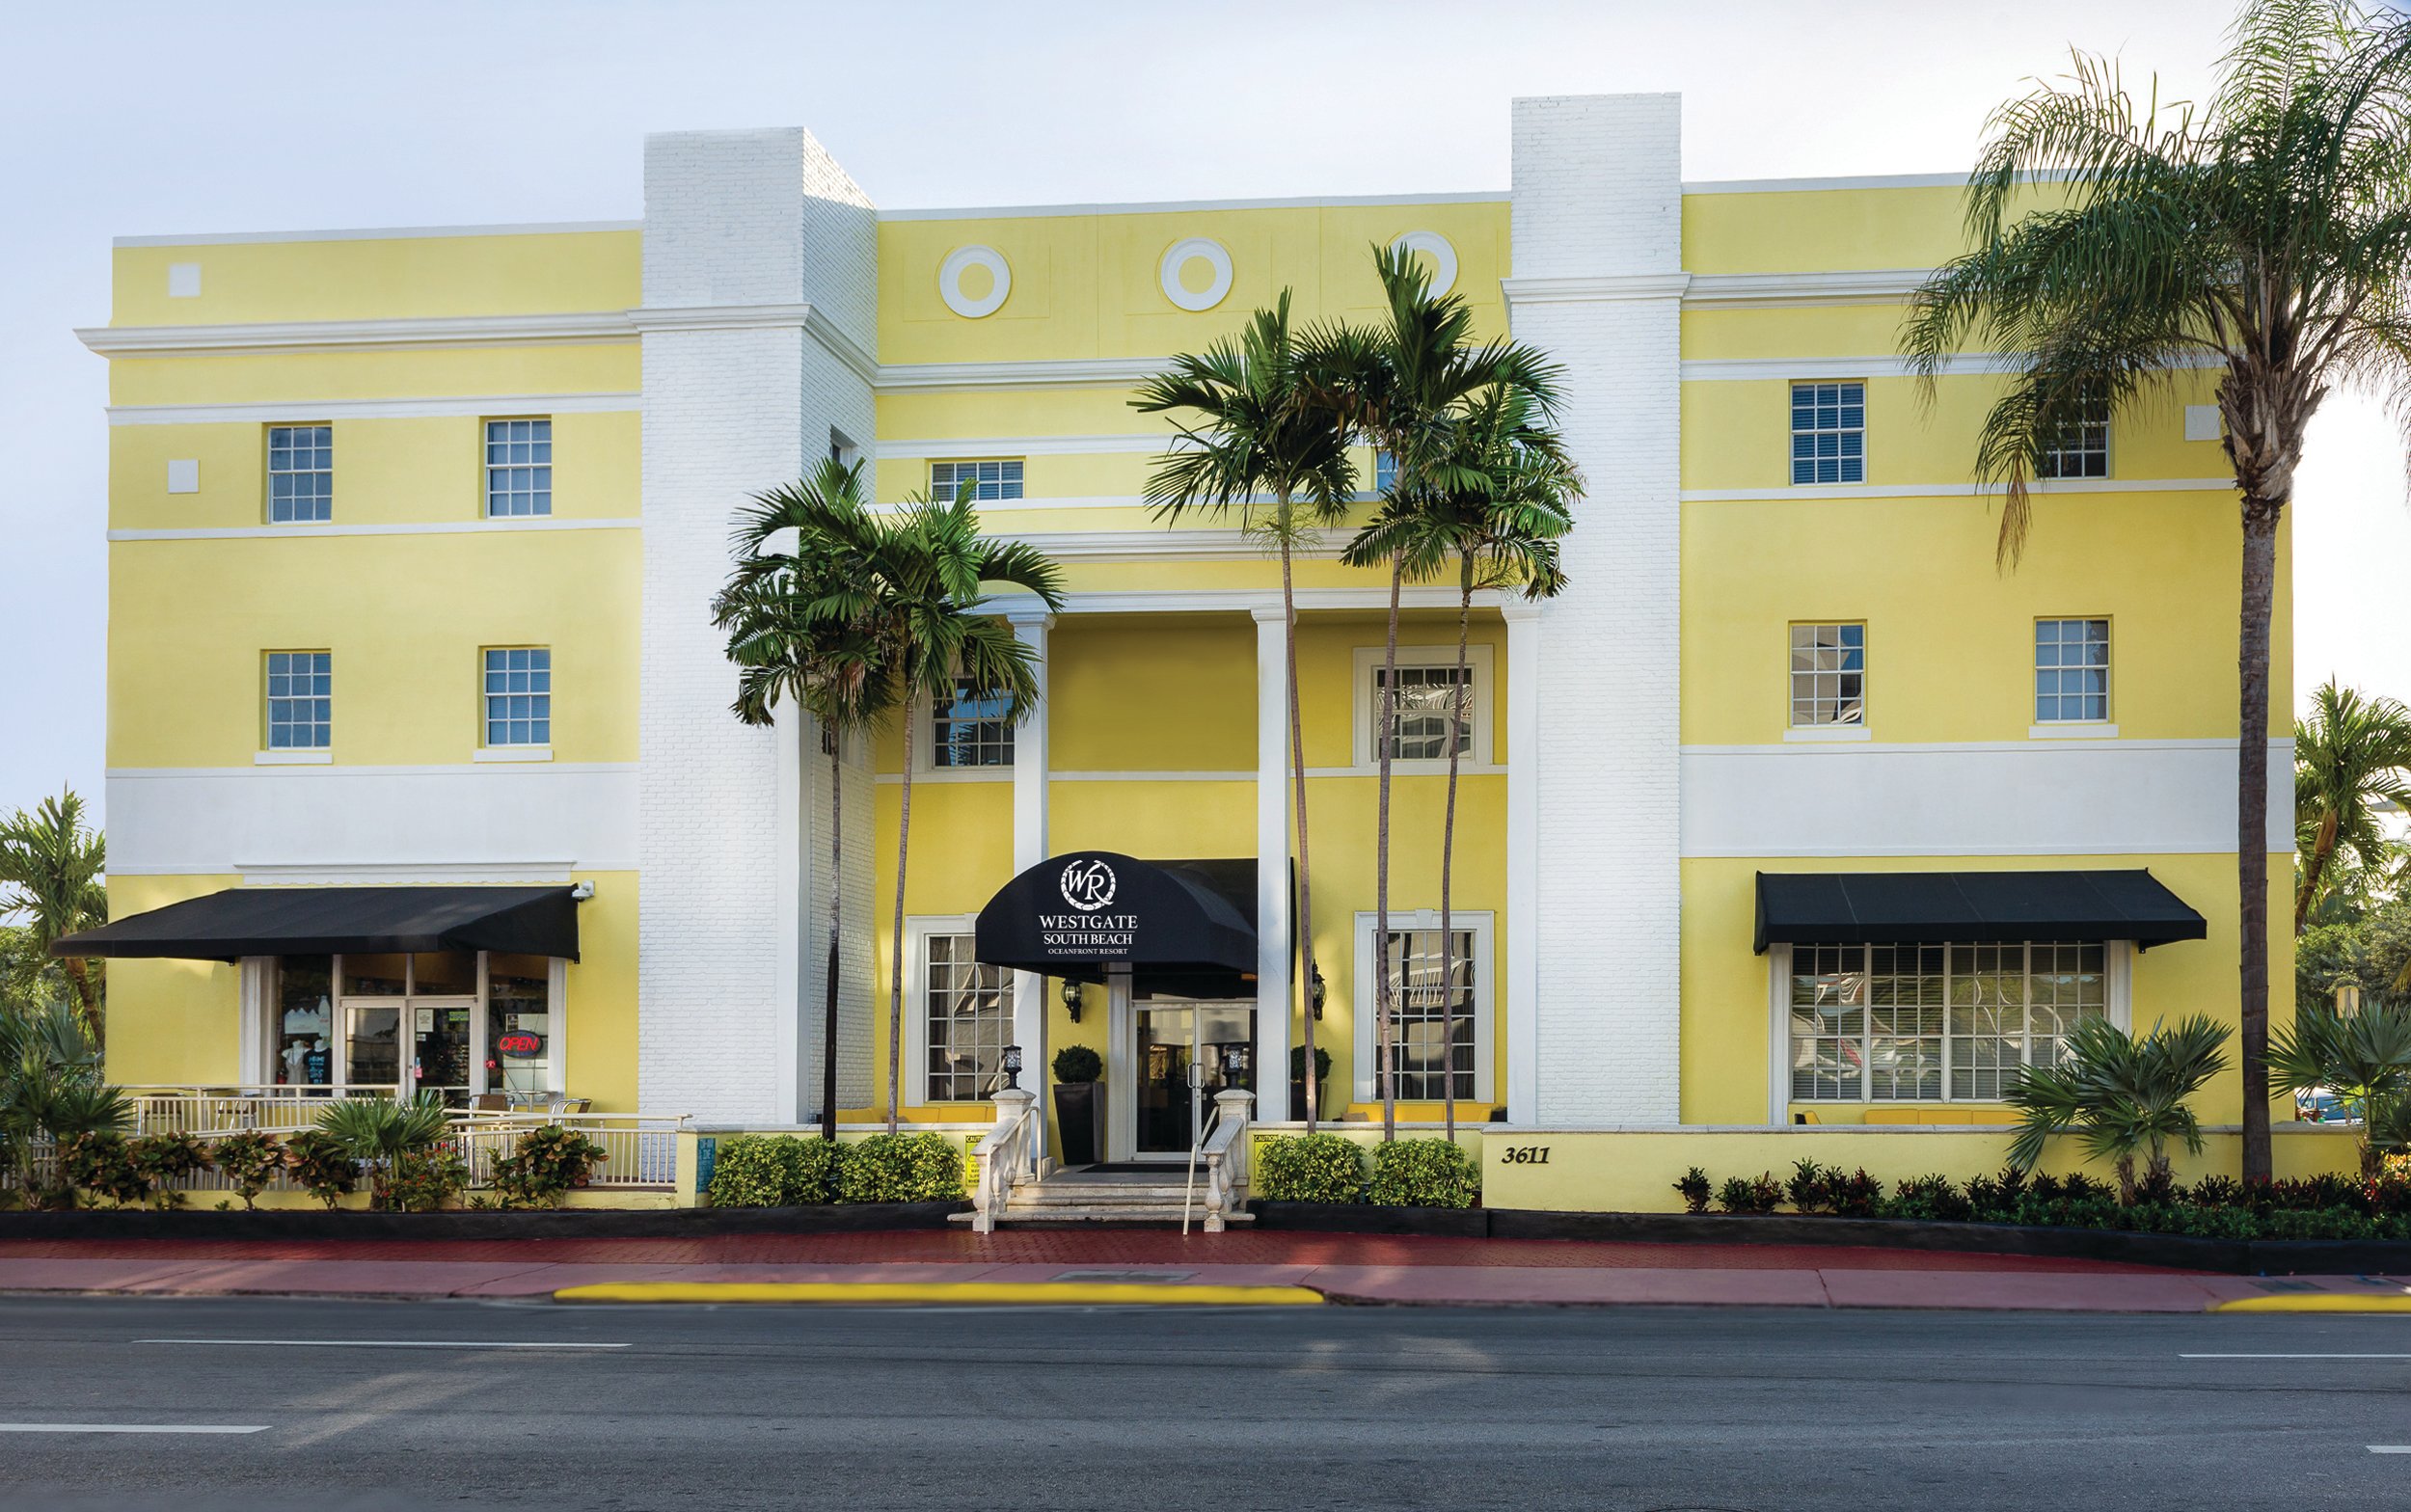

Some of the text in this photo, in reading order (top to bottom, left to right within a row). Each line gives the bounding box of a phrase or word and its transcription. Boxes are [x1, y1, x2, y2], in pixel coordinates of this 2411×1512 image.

[1039, 915, 1138, 929] WESTGATE
[1043, 933, 1133, 945] SOUTH BEACH
[500, 1037, 539, 1051] OPEN
[1502, 1146, 1551, 1165] 3611
